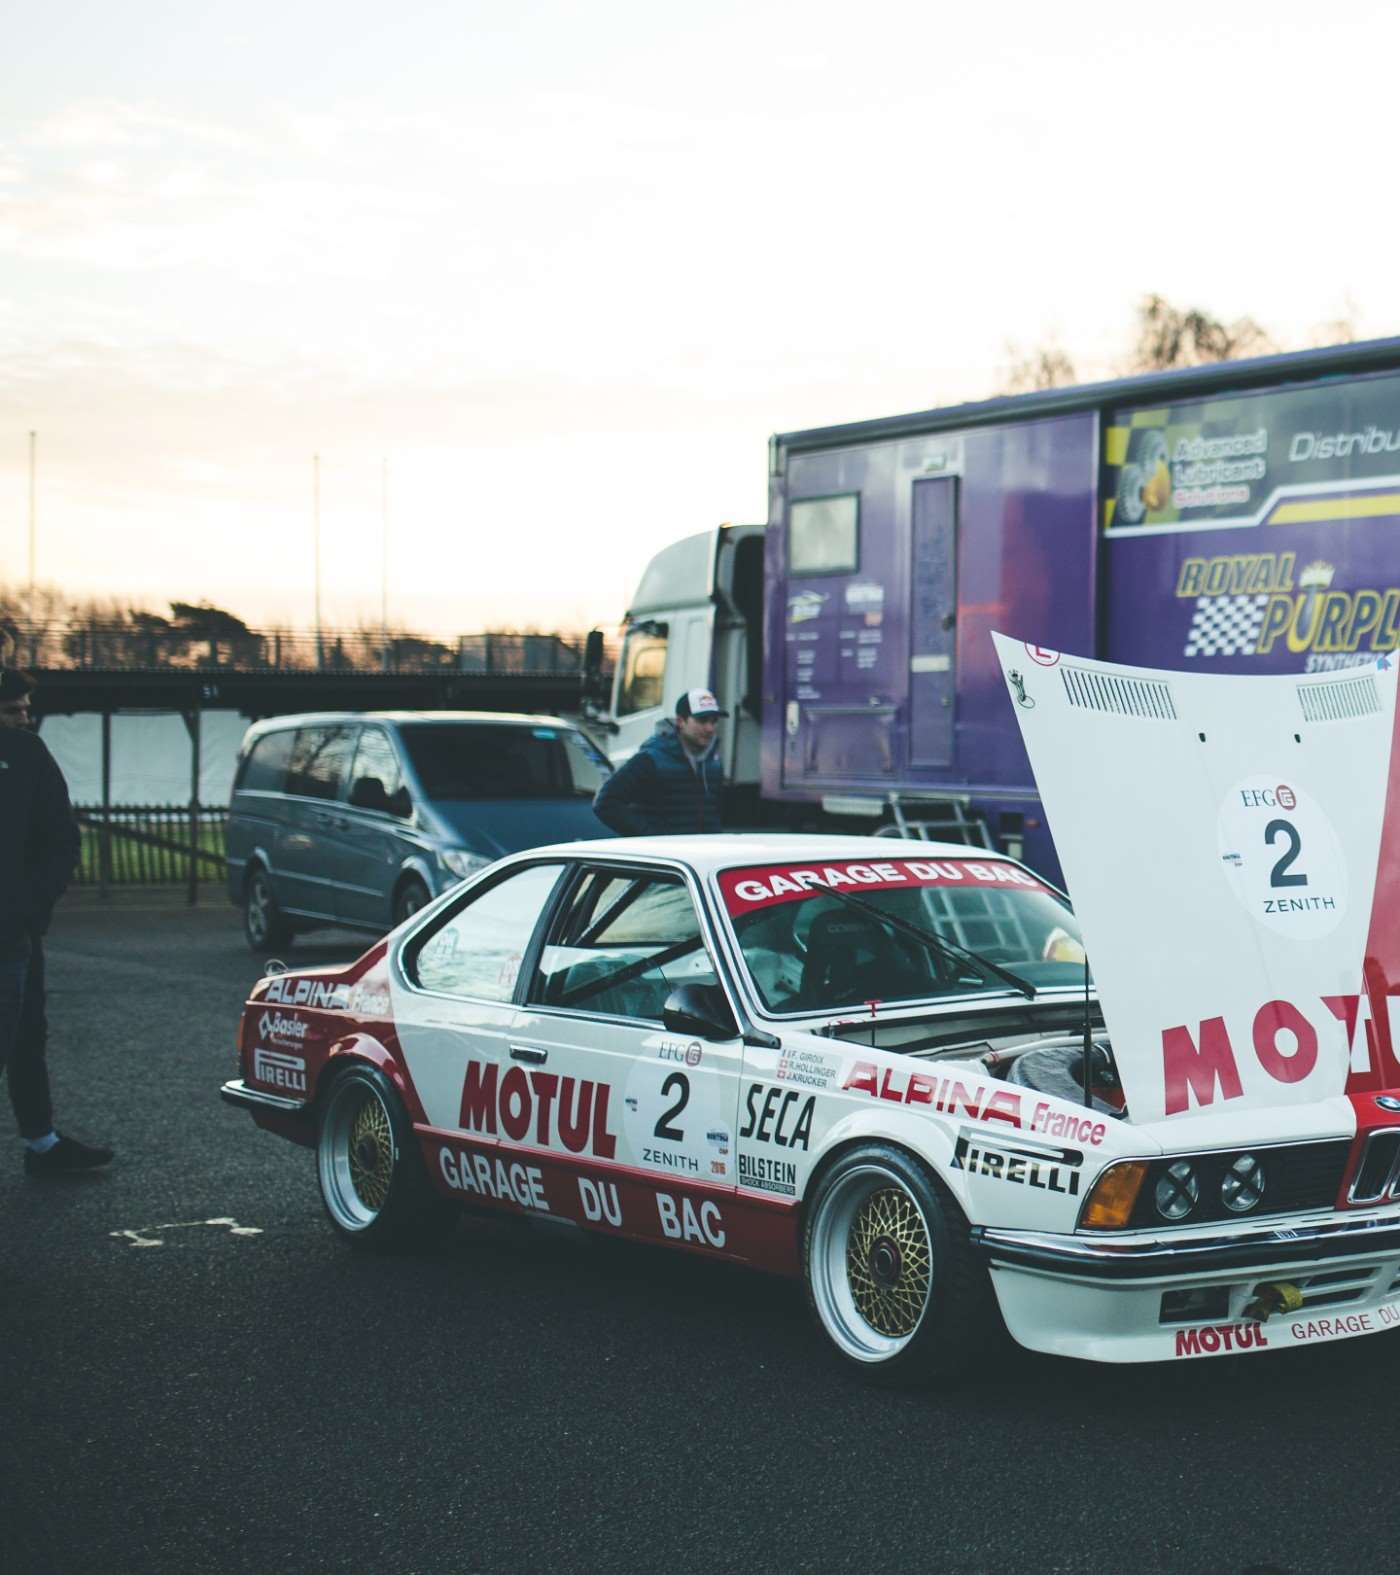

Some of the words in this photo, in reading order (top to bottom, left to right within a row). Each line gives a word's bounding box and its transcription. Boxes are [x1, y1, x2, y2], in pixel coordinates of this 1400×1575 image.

[1176, 552, 1296, 597] ROYAL
[1240, 788, 1276, 807] EFG
[1264, 818, 1308, 888] 2
[734, 863, 907, 902] GARAGE
[905, 862, 963, 881] DU
[962, 863, 1038, 887] BAC
[1263, 896, 1335, 913] ZENITH
[264, 978, 355, 1010] ALPINA
[254, 1048, 306, 1091] PIRELLI
[658, 1041, 684, 1062] EFG
[459, 1060, 617, 1159] MOTUL
[654, 1072, 690, 1142] 2
[739, 1083, 816, 1151] SECA
[842, 1060, 1022, 1129] ALPINA
[1030, 1102, 1106, 1146] France
[643, 1148, 699, 1172] ZENITH
[739, 1154, 796, 1185] BILSTEIN
[950, 1125, 1084, 1196] PIRELLI
[439, 1147, 550, 1211] GARAGE
[578, 1177, 622, 1227] DU
[655, 1192, 726, 1248] BAC
[1175, 1322, 1267, 1356] MOTUL
[1291, 1314, 1374, 1340] GARAGE
[1378, 1304, 1400, 1324] DU
